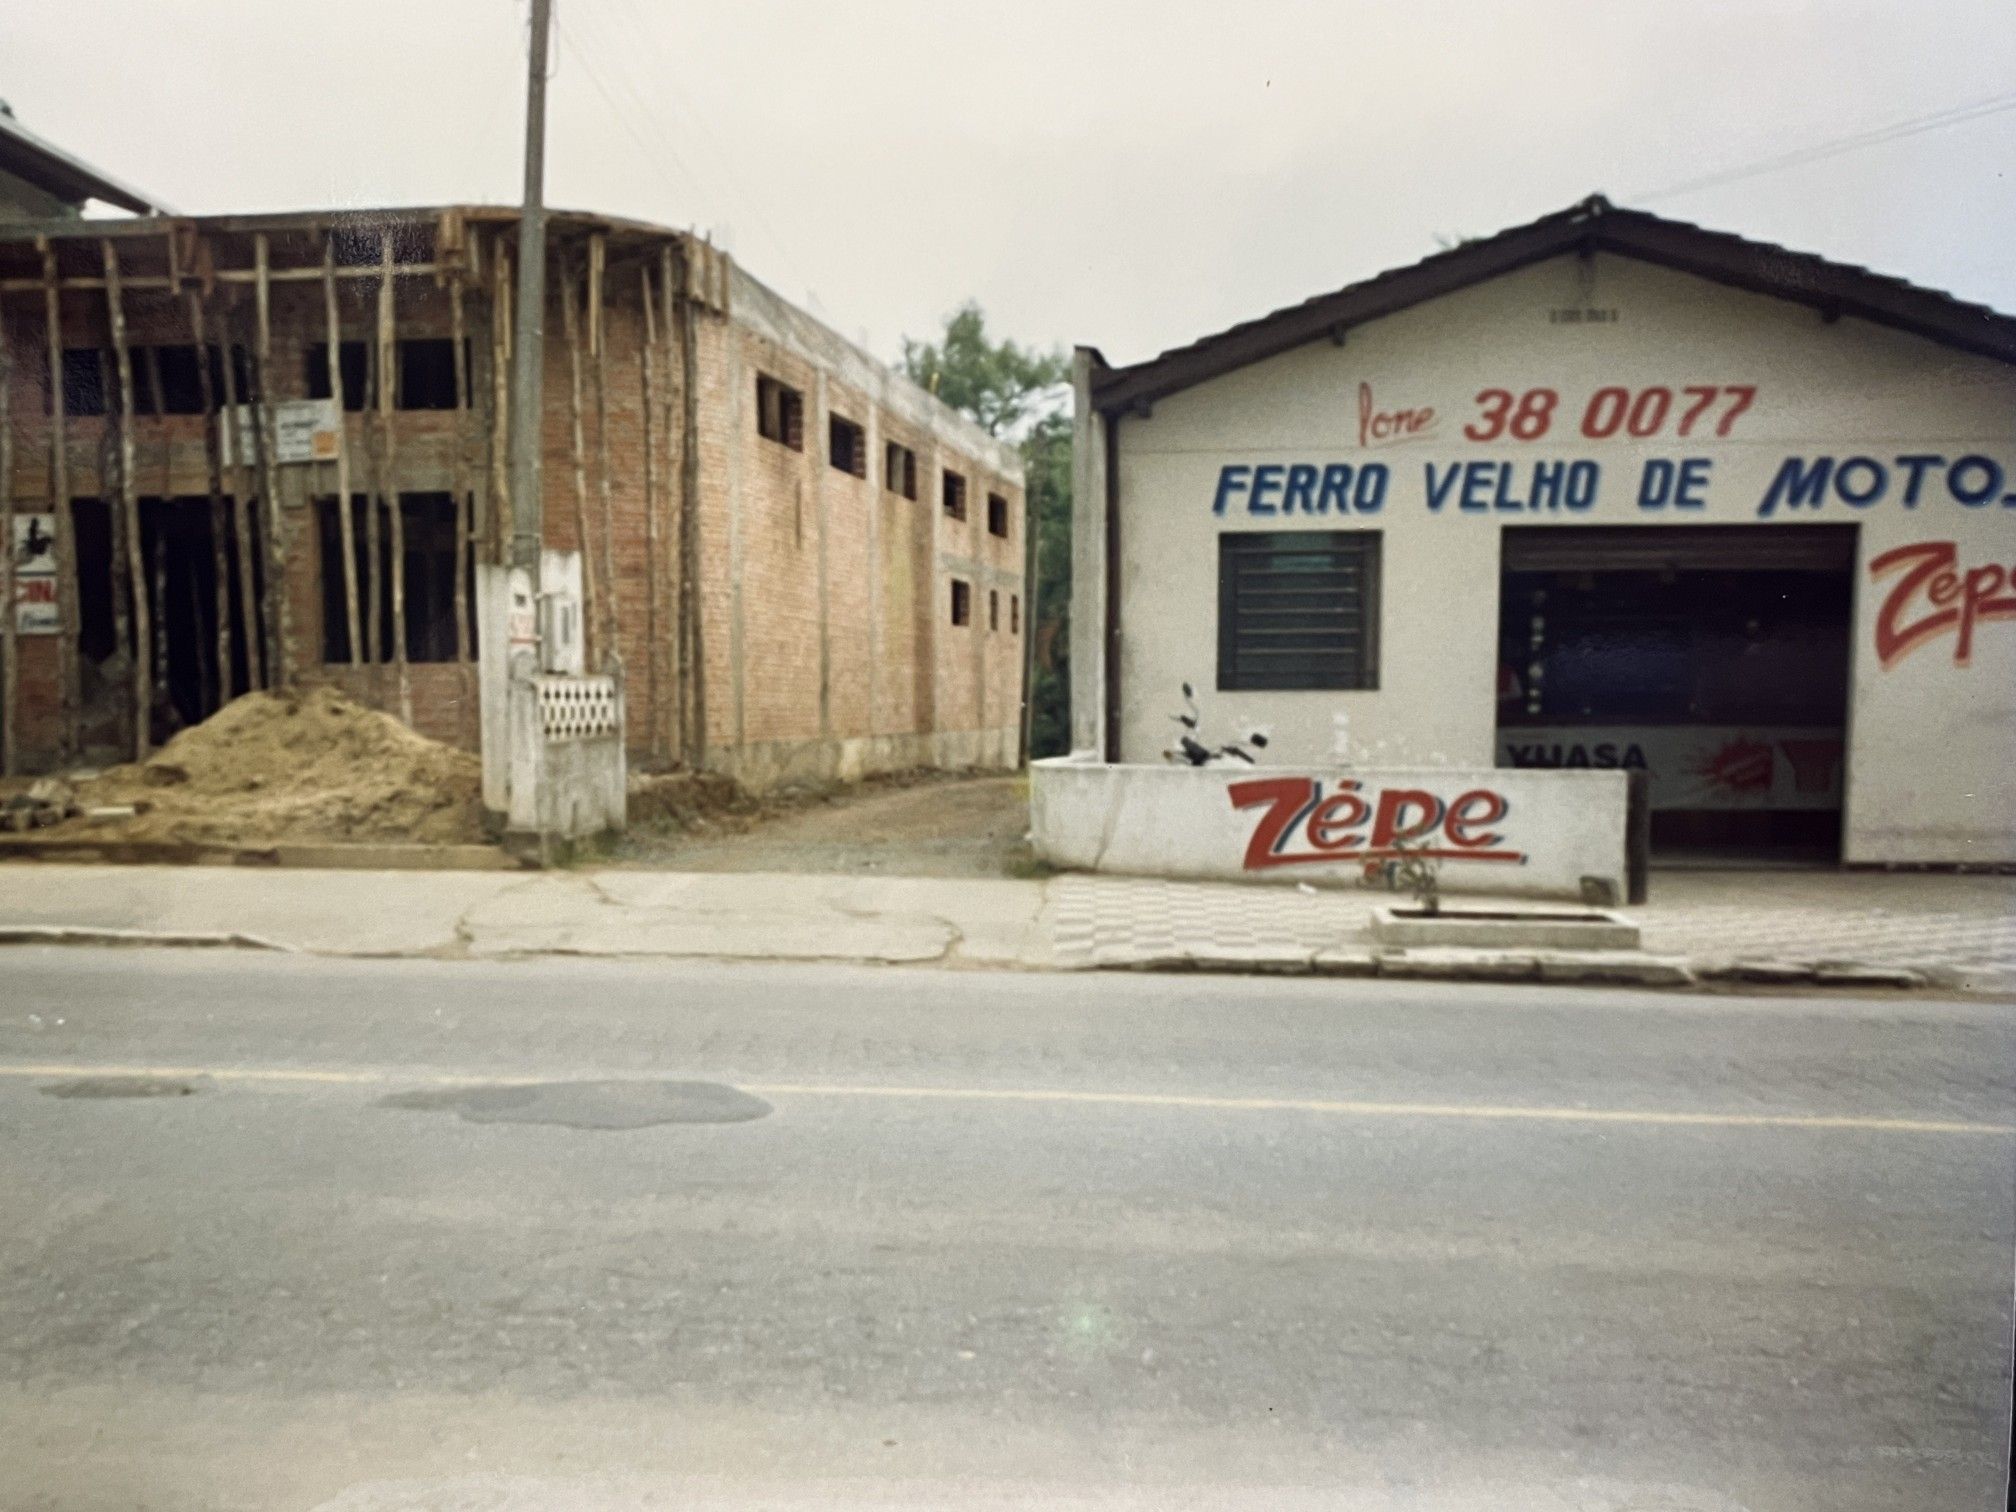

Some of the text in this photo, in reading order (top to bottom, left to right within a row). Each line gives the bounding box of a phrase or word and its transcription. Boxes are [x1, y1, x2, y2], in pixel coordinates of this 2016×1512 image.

[1464, 388, 1559, 441] 38
[1580, 385, 1757, 439] 0077
[1212, 462, 1391, 516] FERRO
[1424, 459, 1601, 514] VELHO
[1637, 458, 1712, 510] DE
[1869, 540, 2016, 673] Zep
[1505, 743, 1647, 770] YUASA
